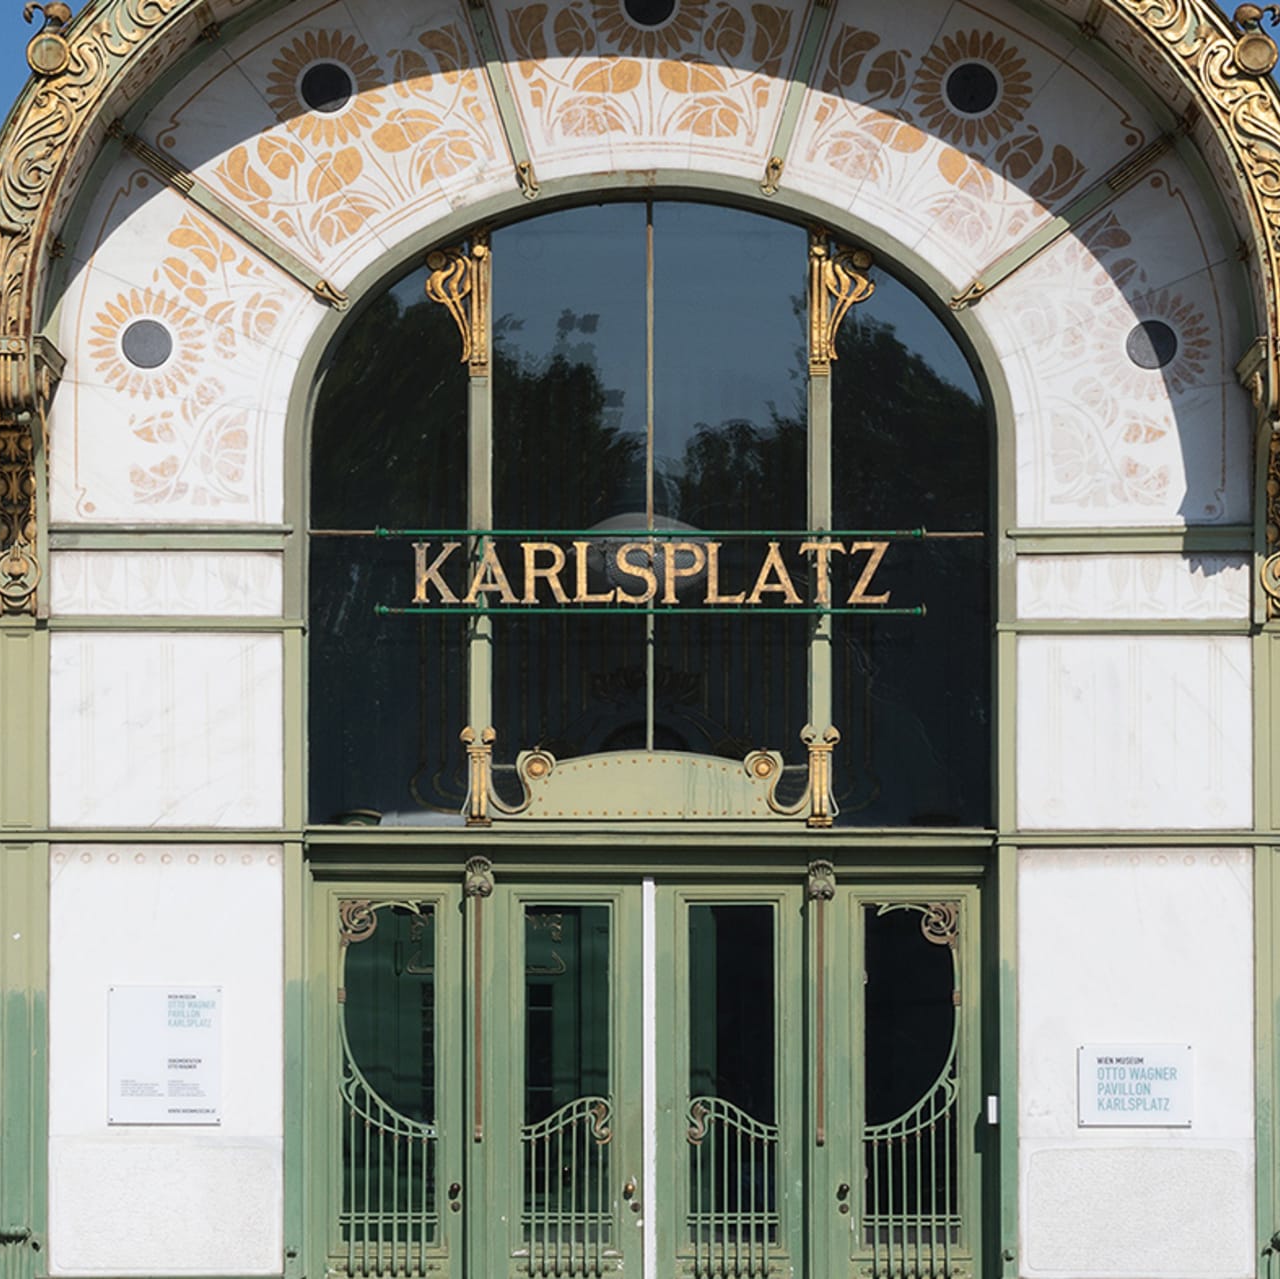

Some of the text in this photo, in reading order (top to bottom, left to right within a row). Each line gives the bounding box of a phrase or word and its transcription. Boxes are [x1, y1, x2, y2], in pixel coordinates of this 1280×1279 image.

[410, 541, 891, 605] KARLSPLATZ
[1096, 1056, 1144, 1065] WIEN MUSEUM
[1096, 1066, 1178, 1080] OTTO WAGNER
[1097, 1082, 1151, 1095] PAVILLON
[1097, 1097, 1170, 1111] KARLSPLATZ
